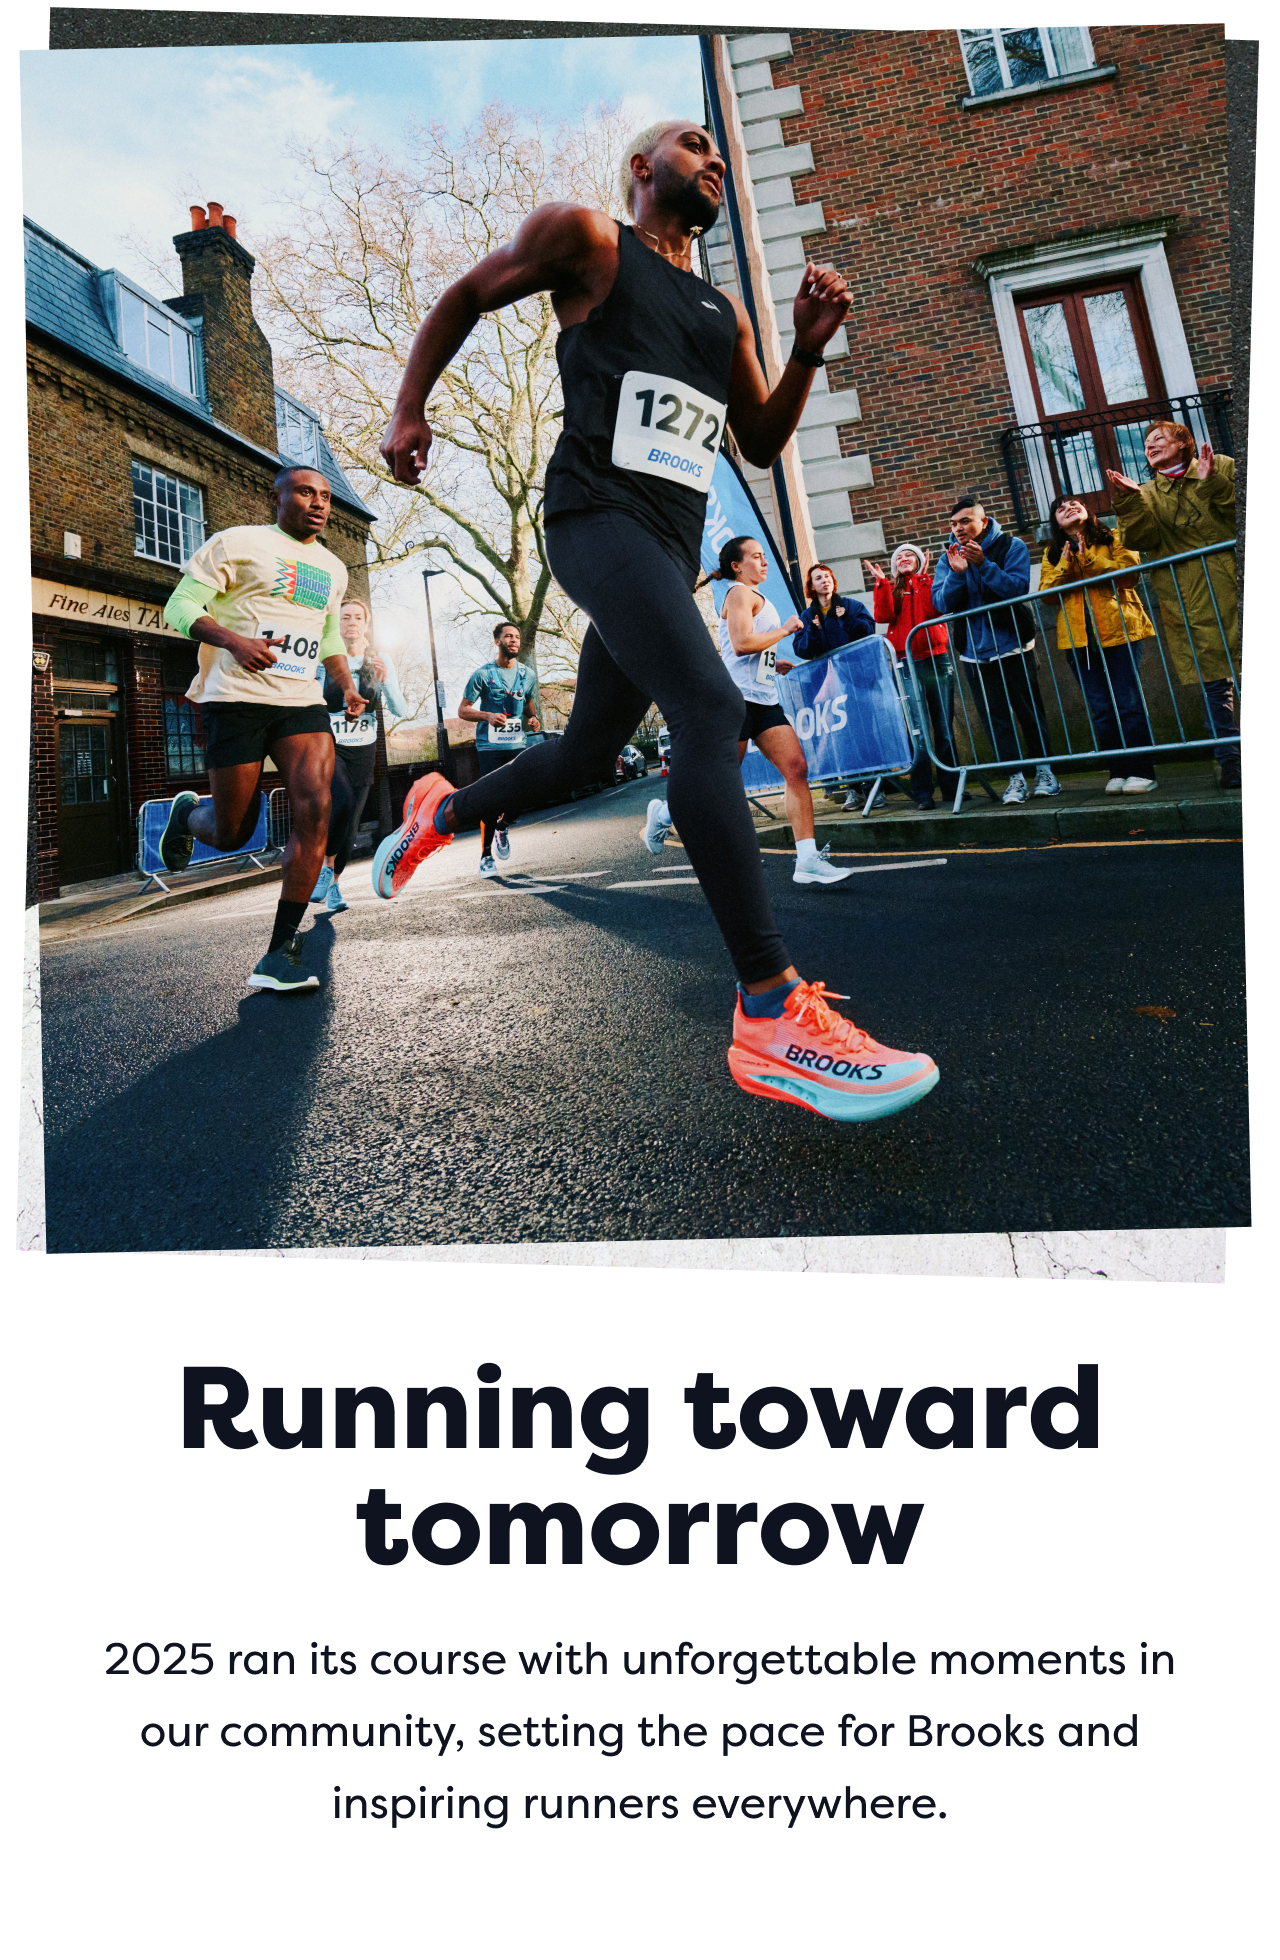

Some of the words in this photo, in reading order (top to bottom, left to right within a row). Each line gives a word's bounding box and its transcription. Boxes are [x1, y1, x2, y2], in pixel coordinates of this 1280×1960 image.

[635, 389, 719, 454] 1272
[647, 448, 703, 478] BROOKS
[296, 574, 331, 598] BROOKS
[49, 593, 89, 614] Fine
[92, 604, 130, 622] Ales
[271, 661, 306, 674] BROOKS
[333, 719, 369, 734] 1178
[494, 722, 521, 733] 1235
[385, 821, 419, 878] BROOKS
[785, 1043, 887, 1080] BROOKS
